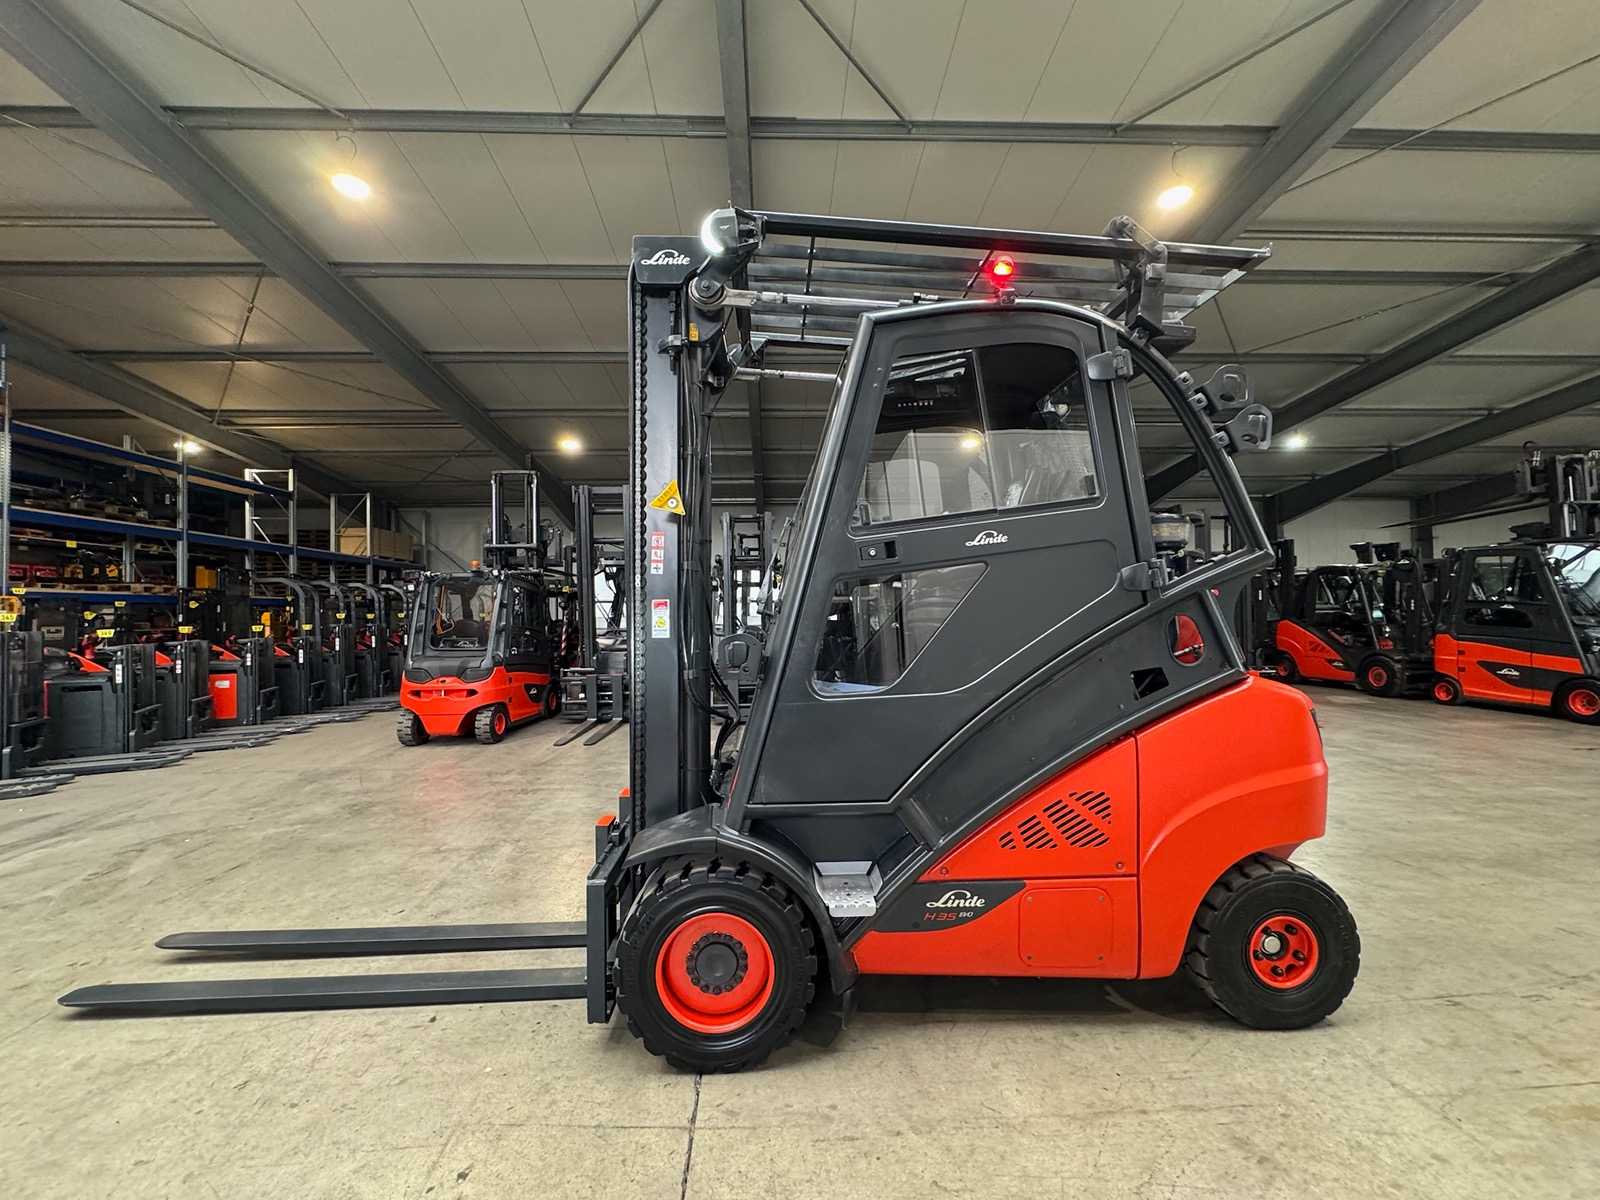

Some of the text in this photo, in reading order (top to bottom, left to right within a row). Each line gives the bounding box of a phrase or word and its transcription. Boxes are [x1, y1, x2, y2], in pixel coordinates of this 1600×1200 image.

[641, 249, 691, 265] Linde
[965, 530, 1008, 546] Linde
[926, 889, 985, 907] Linde
